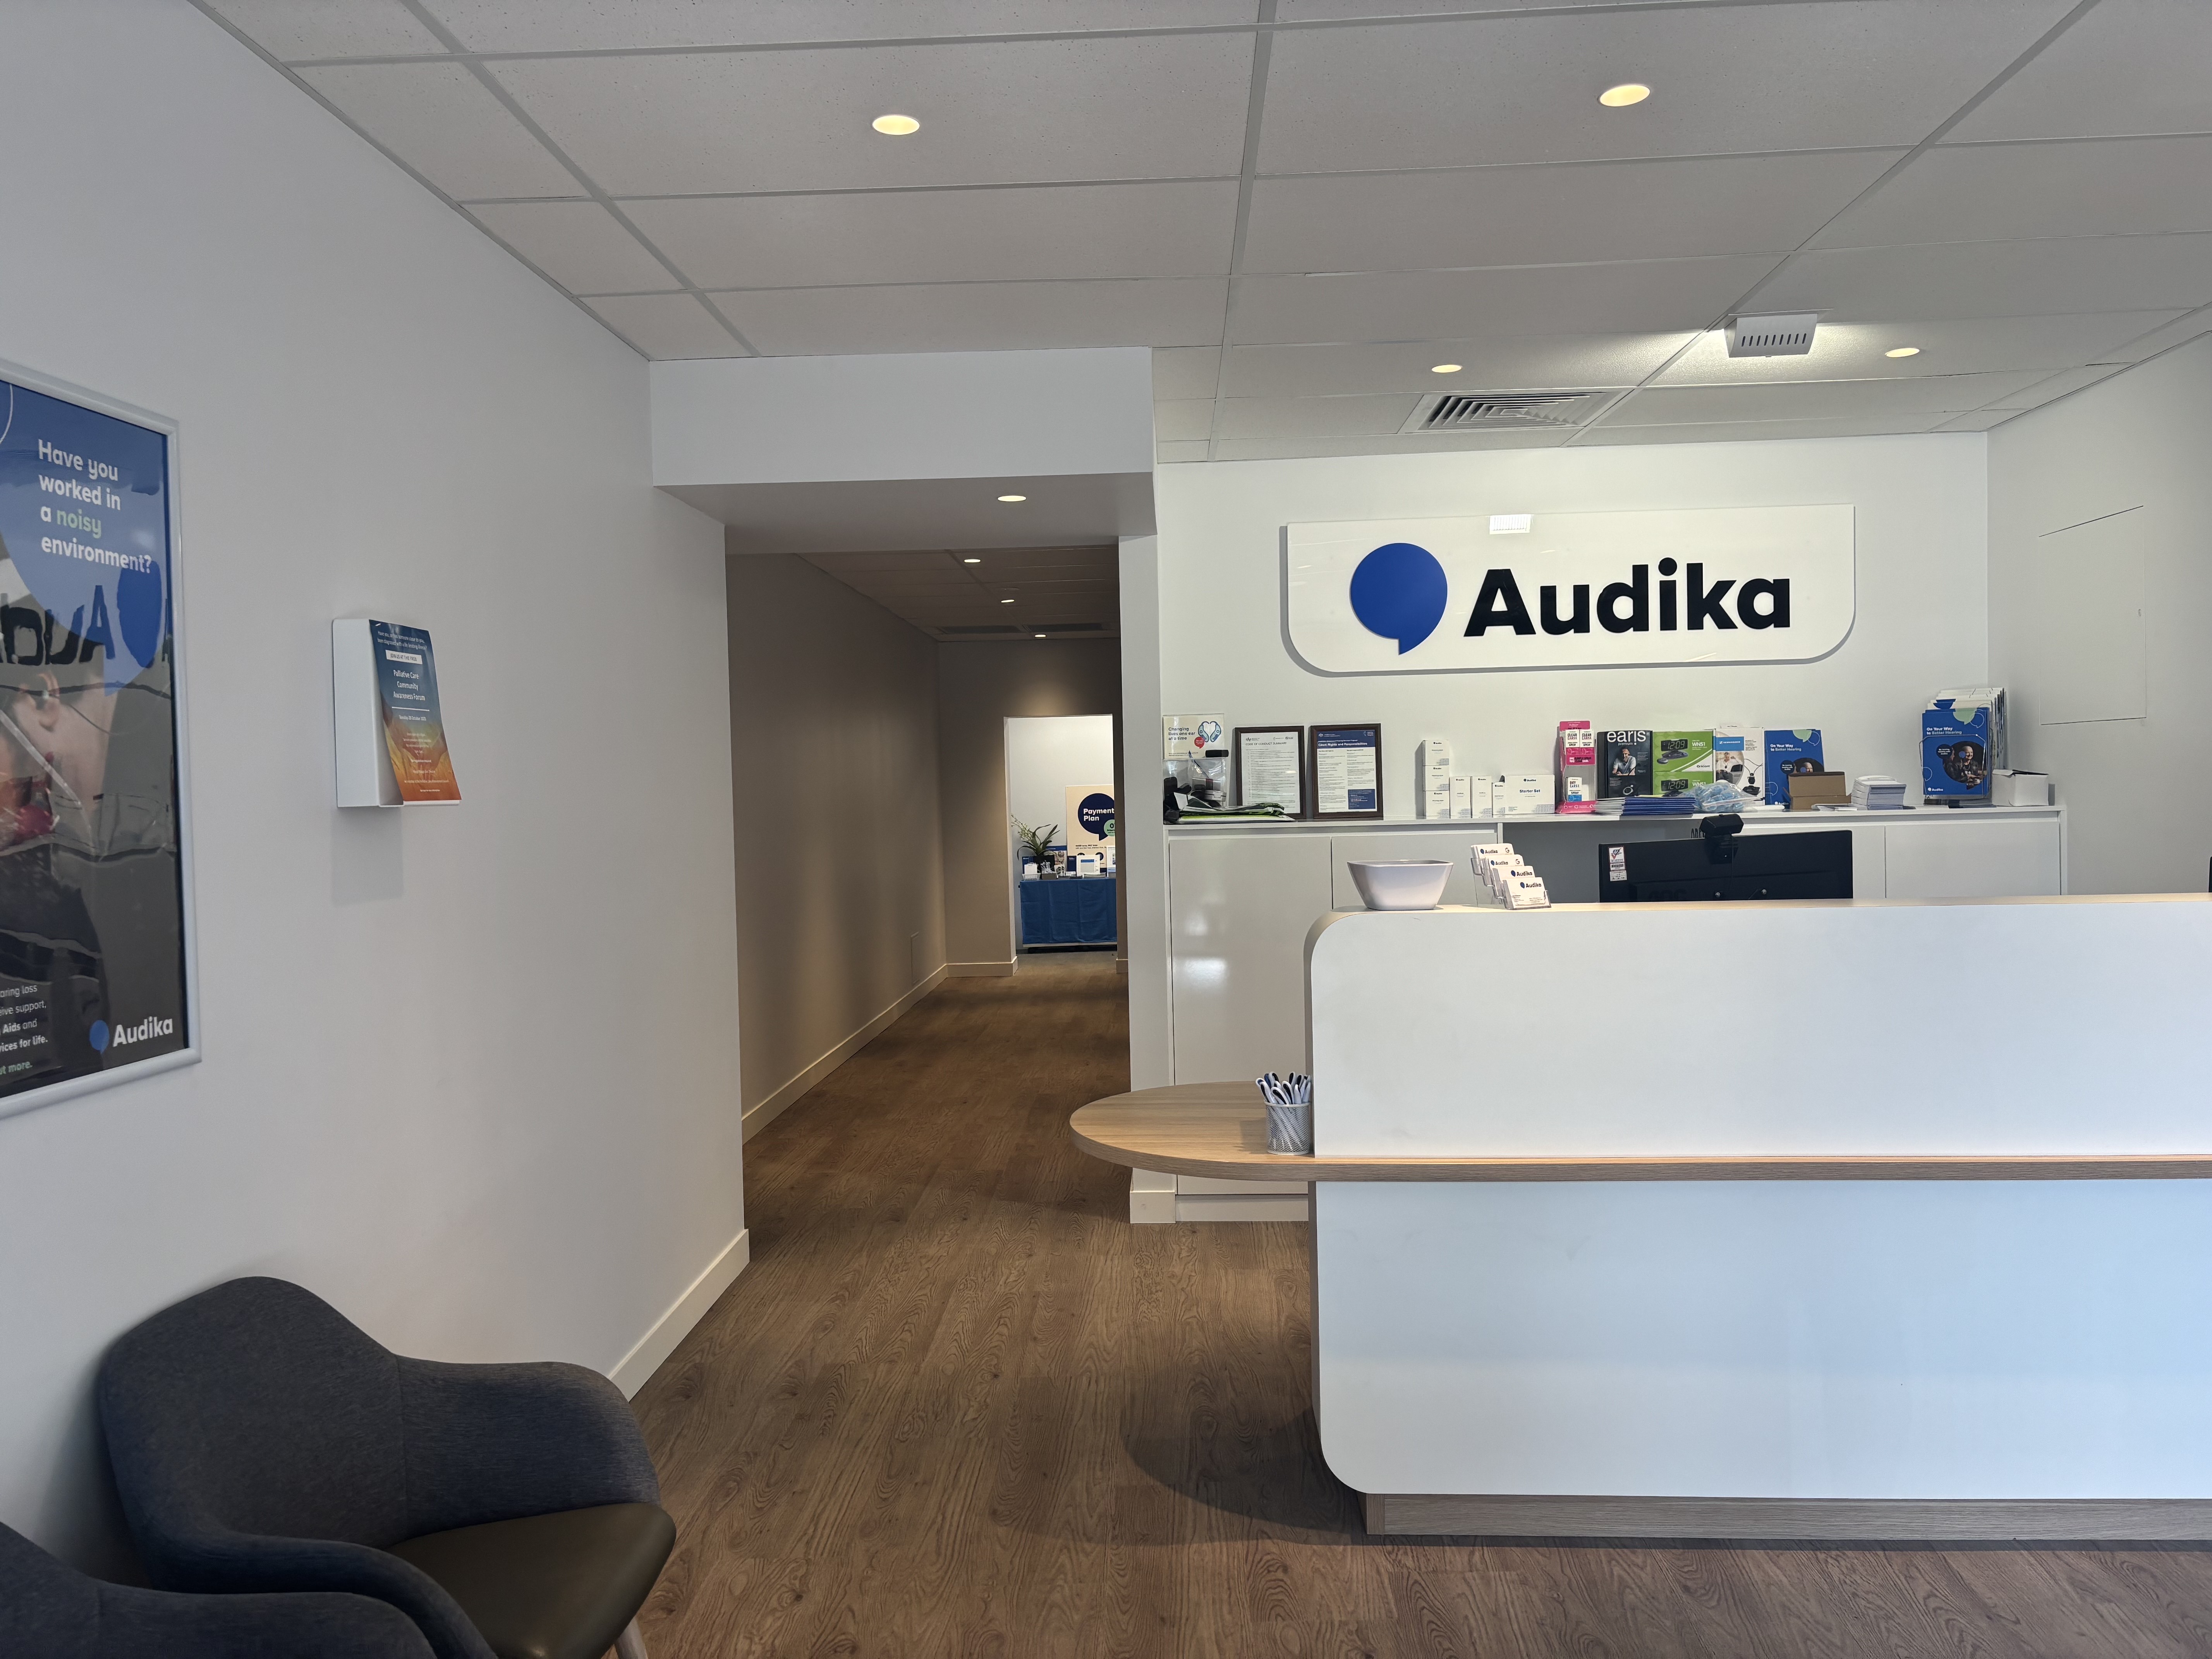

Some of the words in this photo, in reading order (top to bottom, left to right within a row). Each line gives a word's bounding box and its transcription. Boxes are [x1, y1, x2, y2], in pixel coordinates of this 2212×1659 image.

[38, 439, 83, 471] Have
[88, 459, 118, 481] you
[39, 474, 101, 505] worked
[106, 488, 120, 510] in
[41, 506, 51, 522] a
[57, 509, 101, 539] noisy
[41, 537, 152, 573] environment?
[1463, 557, 1790, 637] Audika
[393, 670, 410, 678] Palliative
[397, 681, 418, 691] Community
[393, 691, 413, 700] Awareness
[1668, 741, 1685, 749] 12:09
[1668, 781, 1685, 789] 12:09
[22, 985, 38, 994] loss
[0, 1007, 14, 1016] ive
[2, 1022, 21, 1034] Aids
[23, 1018, 38, 1029] and
[113, 1016, 173, 1047] Audika
[19, 1039, 31, 1048] for
[32, 1035, 48, 1045] life.
